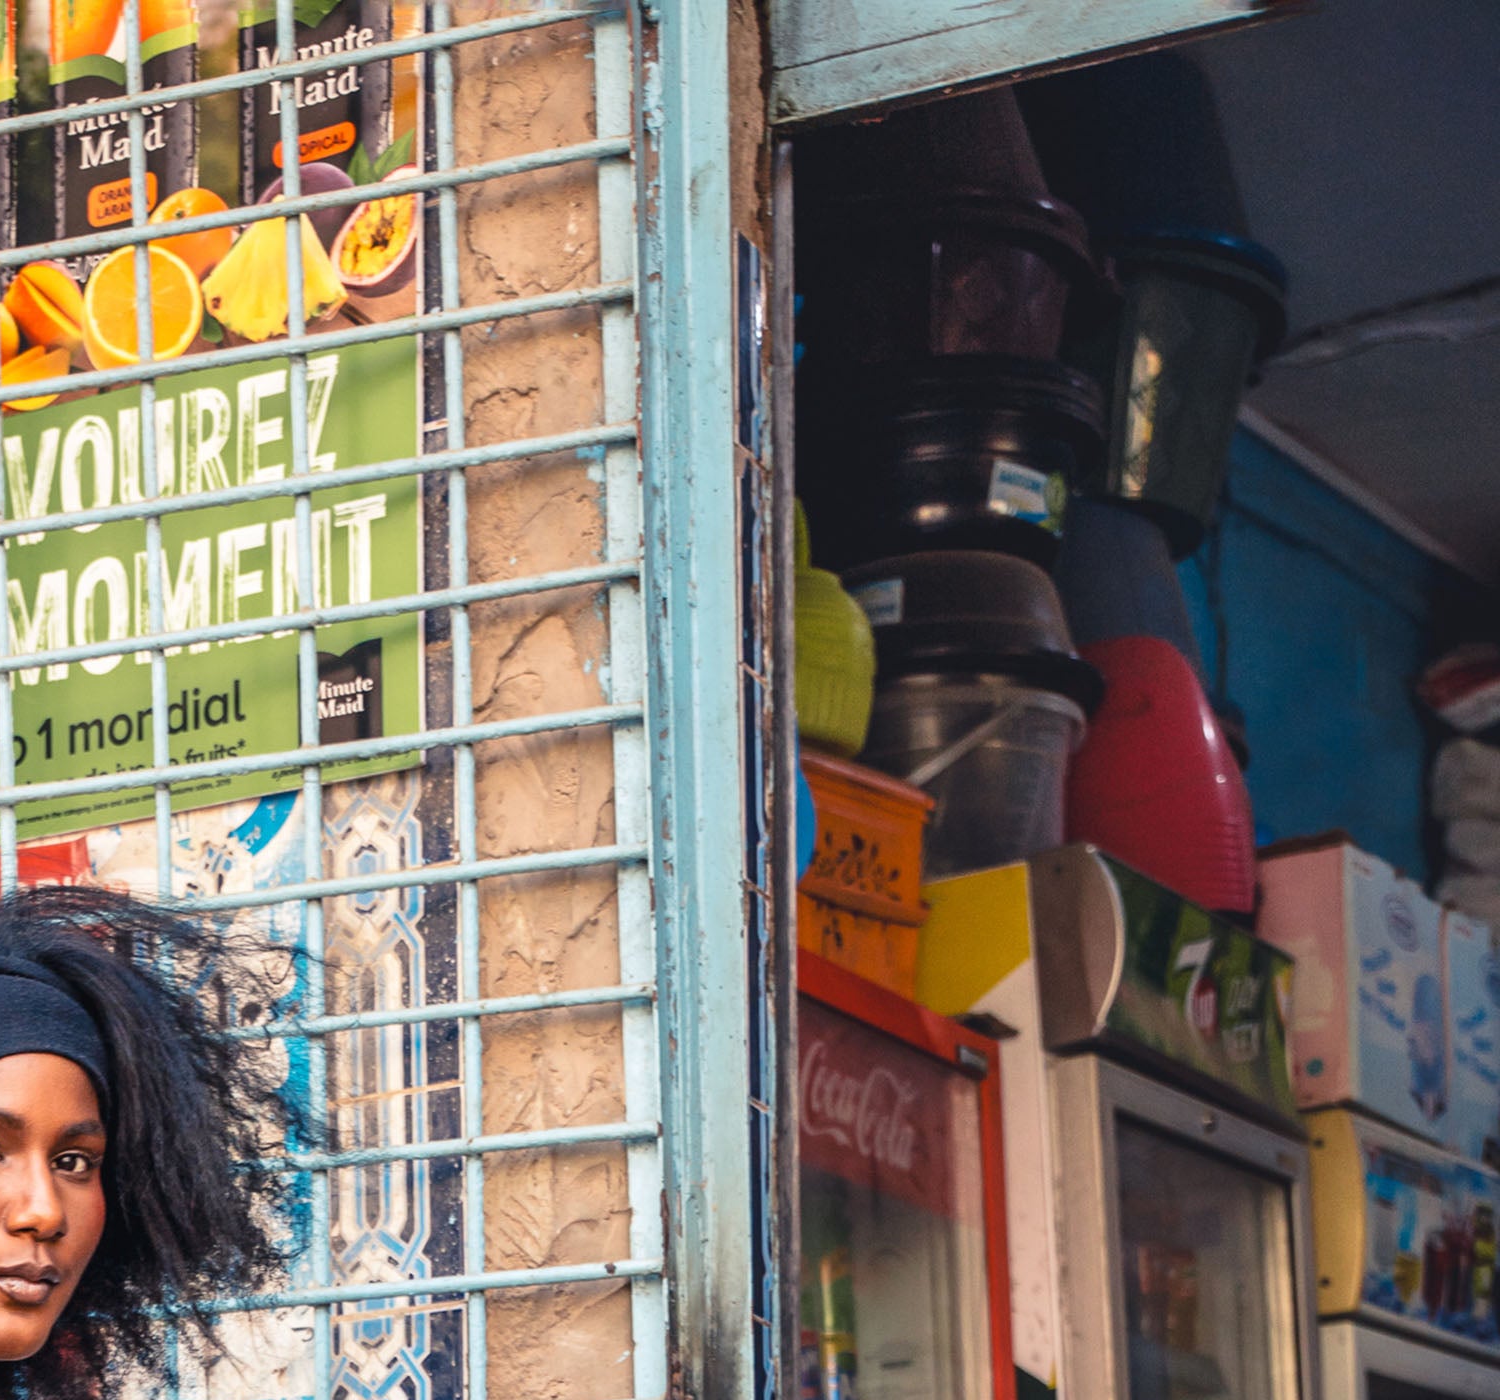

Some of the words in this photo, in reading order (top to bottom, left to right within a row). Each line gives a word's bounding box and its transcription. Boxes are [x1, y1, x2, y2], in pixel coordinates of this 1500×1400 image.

[79, 116, 166, 170] Mad
[300, 131, 348, 156] OPICAL
[7, 493, 388, 691] MOMENT
[37, 717, 53, 760] 1
